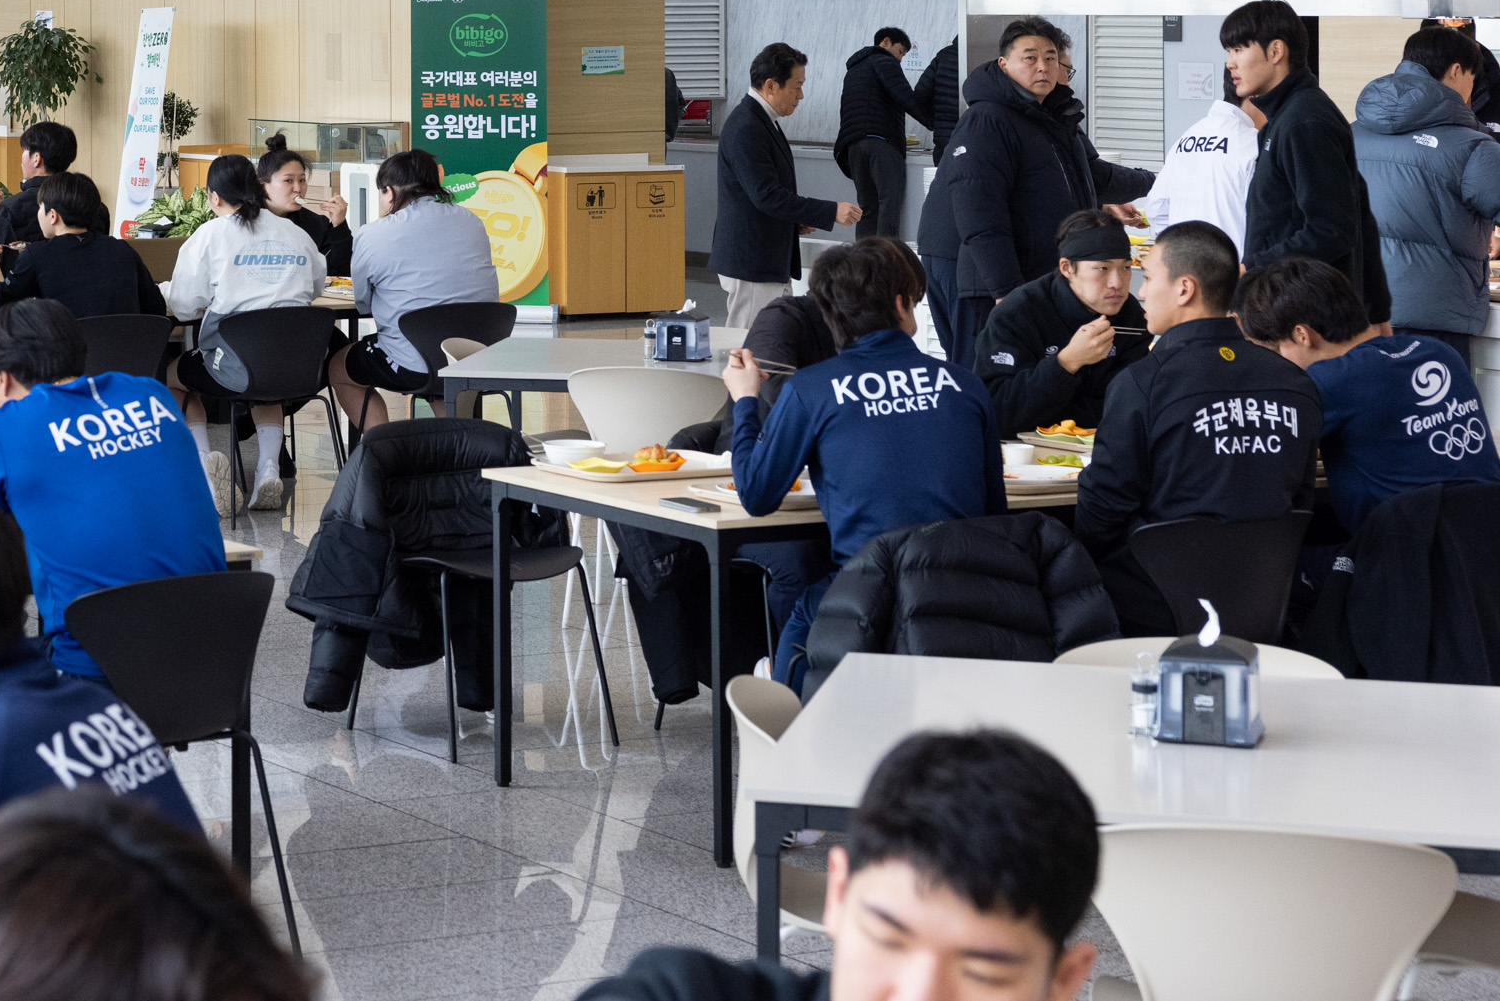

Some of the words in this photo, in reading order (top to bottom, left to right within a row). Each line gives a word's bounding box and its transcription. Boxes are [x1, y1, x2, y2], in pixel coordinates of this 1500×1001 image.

[455, 25, 504, 44] bibigo
[421, 70, 478, 87] 국가대표
[480, 70, 537, 87] 여러분의
[145, 87, 156, 95] SAVE
[421, 93, 460, 108] 글로벌
[463, 94, 495, 107] No.1
[498, 92, 538, 108] 도전을
[139, 97, 148, 105] OUR
[142, 114, 153, 123] SAVE
[421, 114, 537, 140] 응원합니다!
[134, 125, 143, 133] OUR
[1176, 136, 1228, 154] KOREA
[233, 254, 307, 266] UMBRO
[831, 367, 962, 405] KOREA
[864, 393, 940, 417] HOCKEY
[48, 396, 177, 452] KOREA
[1192, 398, 1298, 438] 국군체육부대
[1401, 411, 1445, 436] Team
[1445, 397, 1479, 421] Korea
[88, 427, 162, 460] HOCKEY
[1215, 435, 1281, 454] KAFAC
